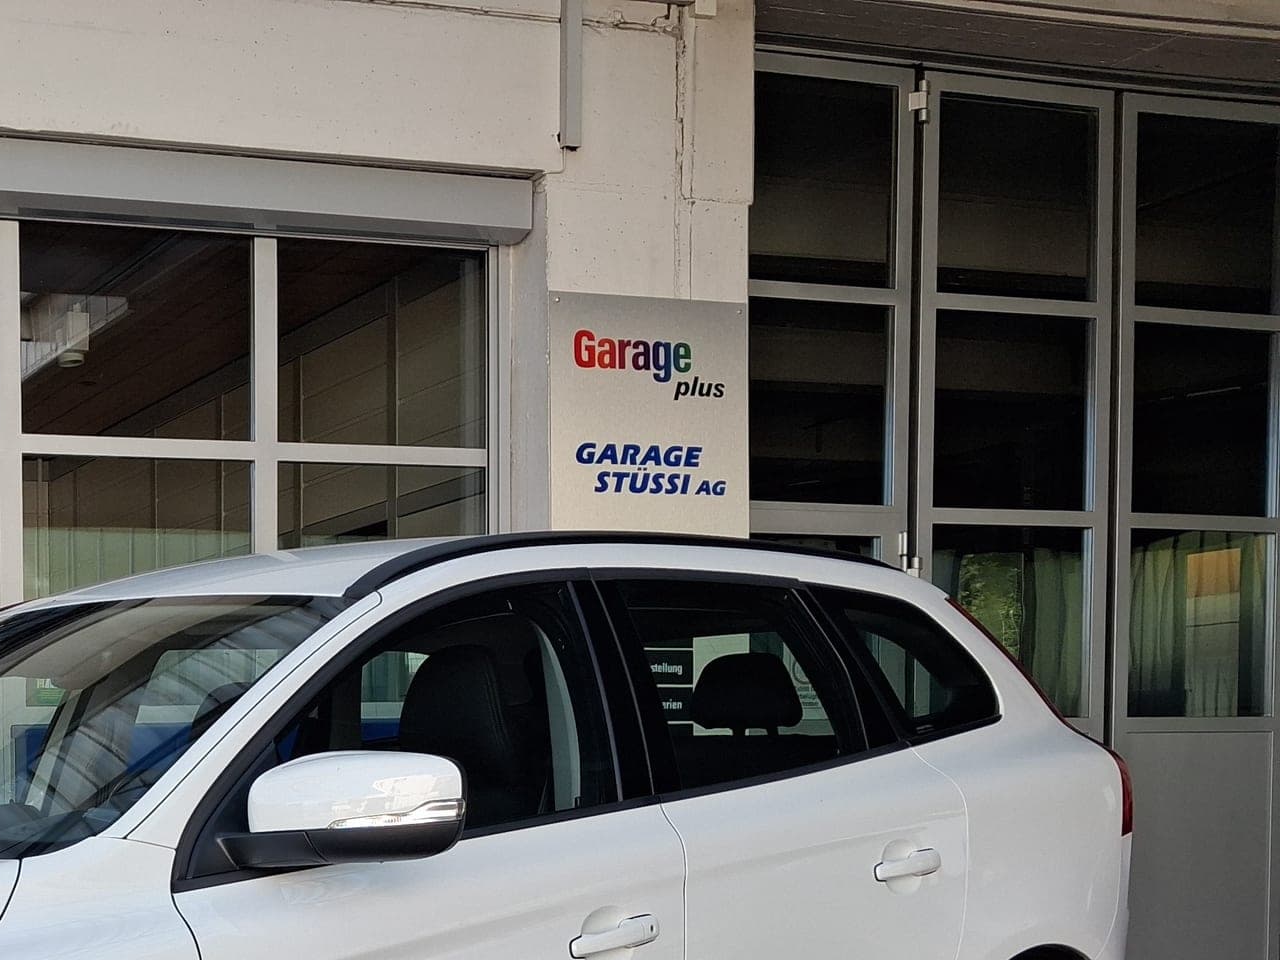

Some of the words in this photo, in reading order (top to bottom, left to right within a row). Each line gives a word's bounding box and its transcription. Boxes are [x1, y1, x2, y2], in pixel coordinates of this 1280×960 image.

[573, 329, 692, 383] Garage
[673, 376, 725, 401] plus
[575, 442, 703, 467] GARAGE
[594, 467, 691, 495] STÜSSI
[695, 480, 727, 496] AG
